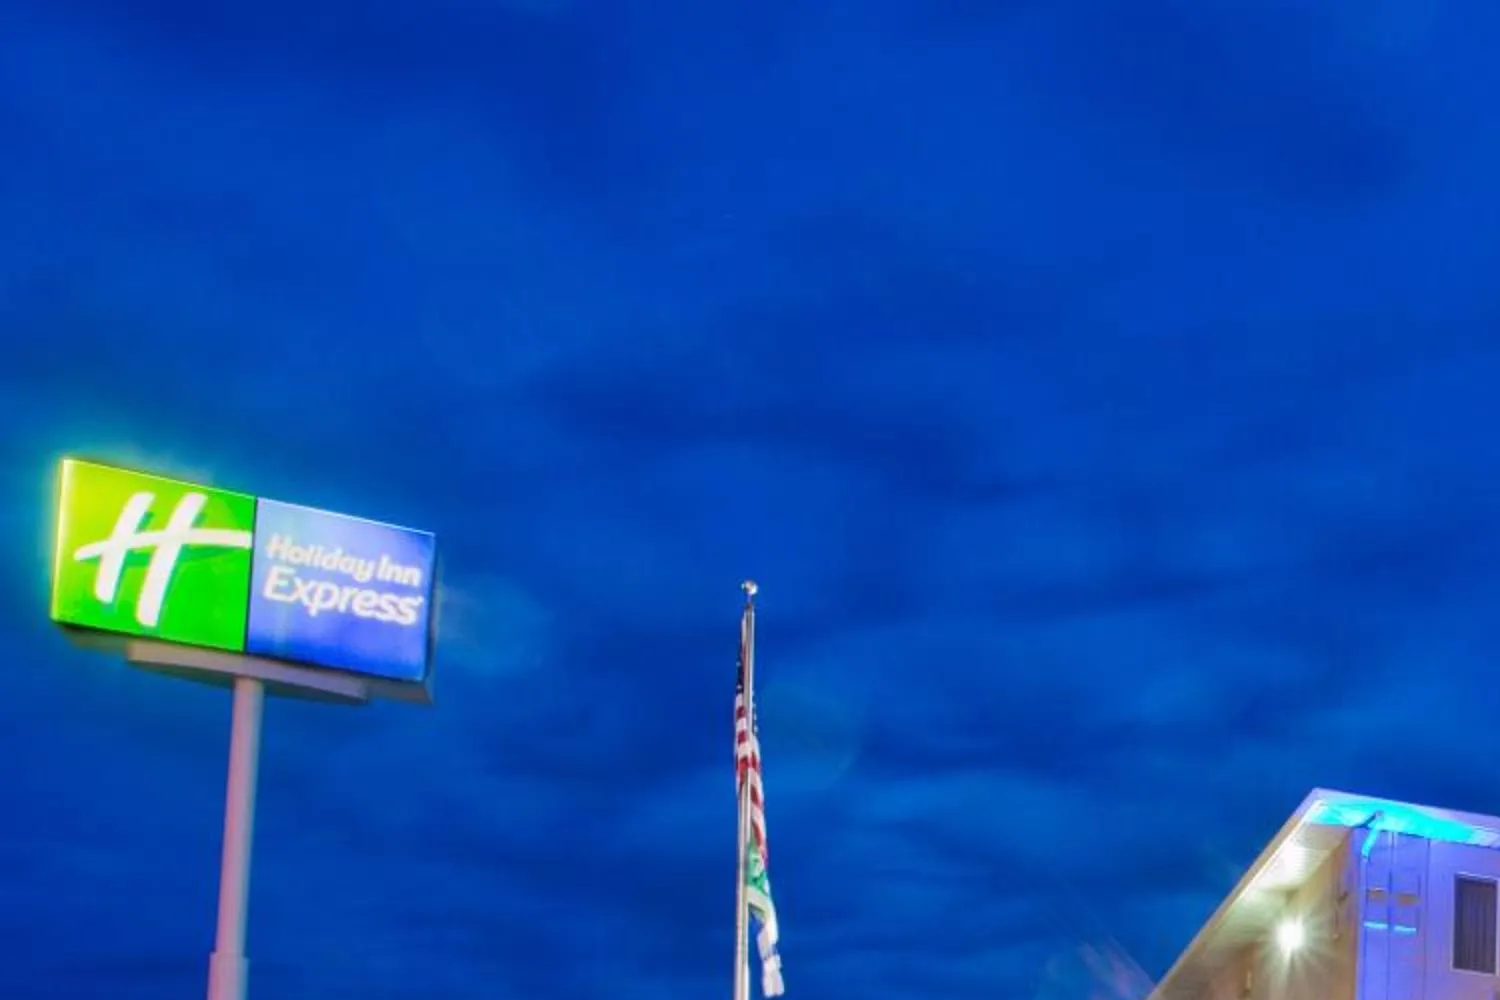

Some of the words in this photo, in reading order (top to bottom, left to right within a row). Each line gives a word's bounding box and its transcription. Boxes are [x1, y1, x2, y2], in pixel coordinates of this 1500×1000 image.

[74, 492, 252, 627] H
[267, 533, 374, 583] Holiday
[377, 554, 421, 586] Inn
[264, 565, 424, 625] Express
